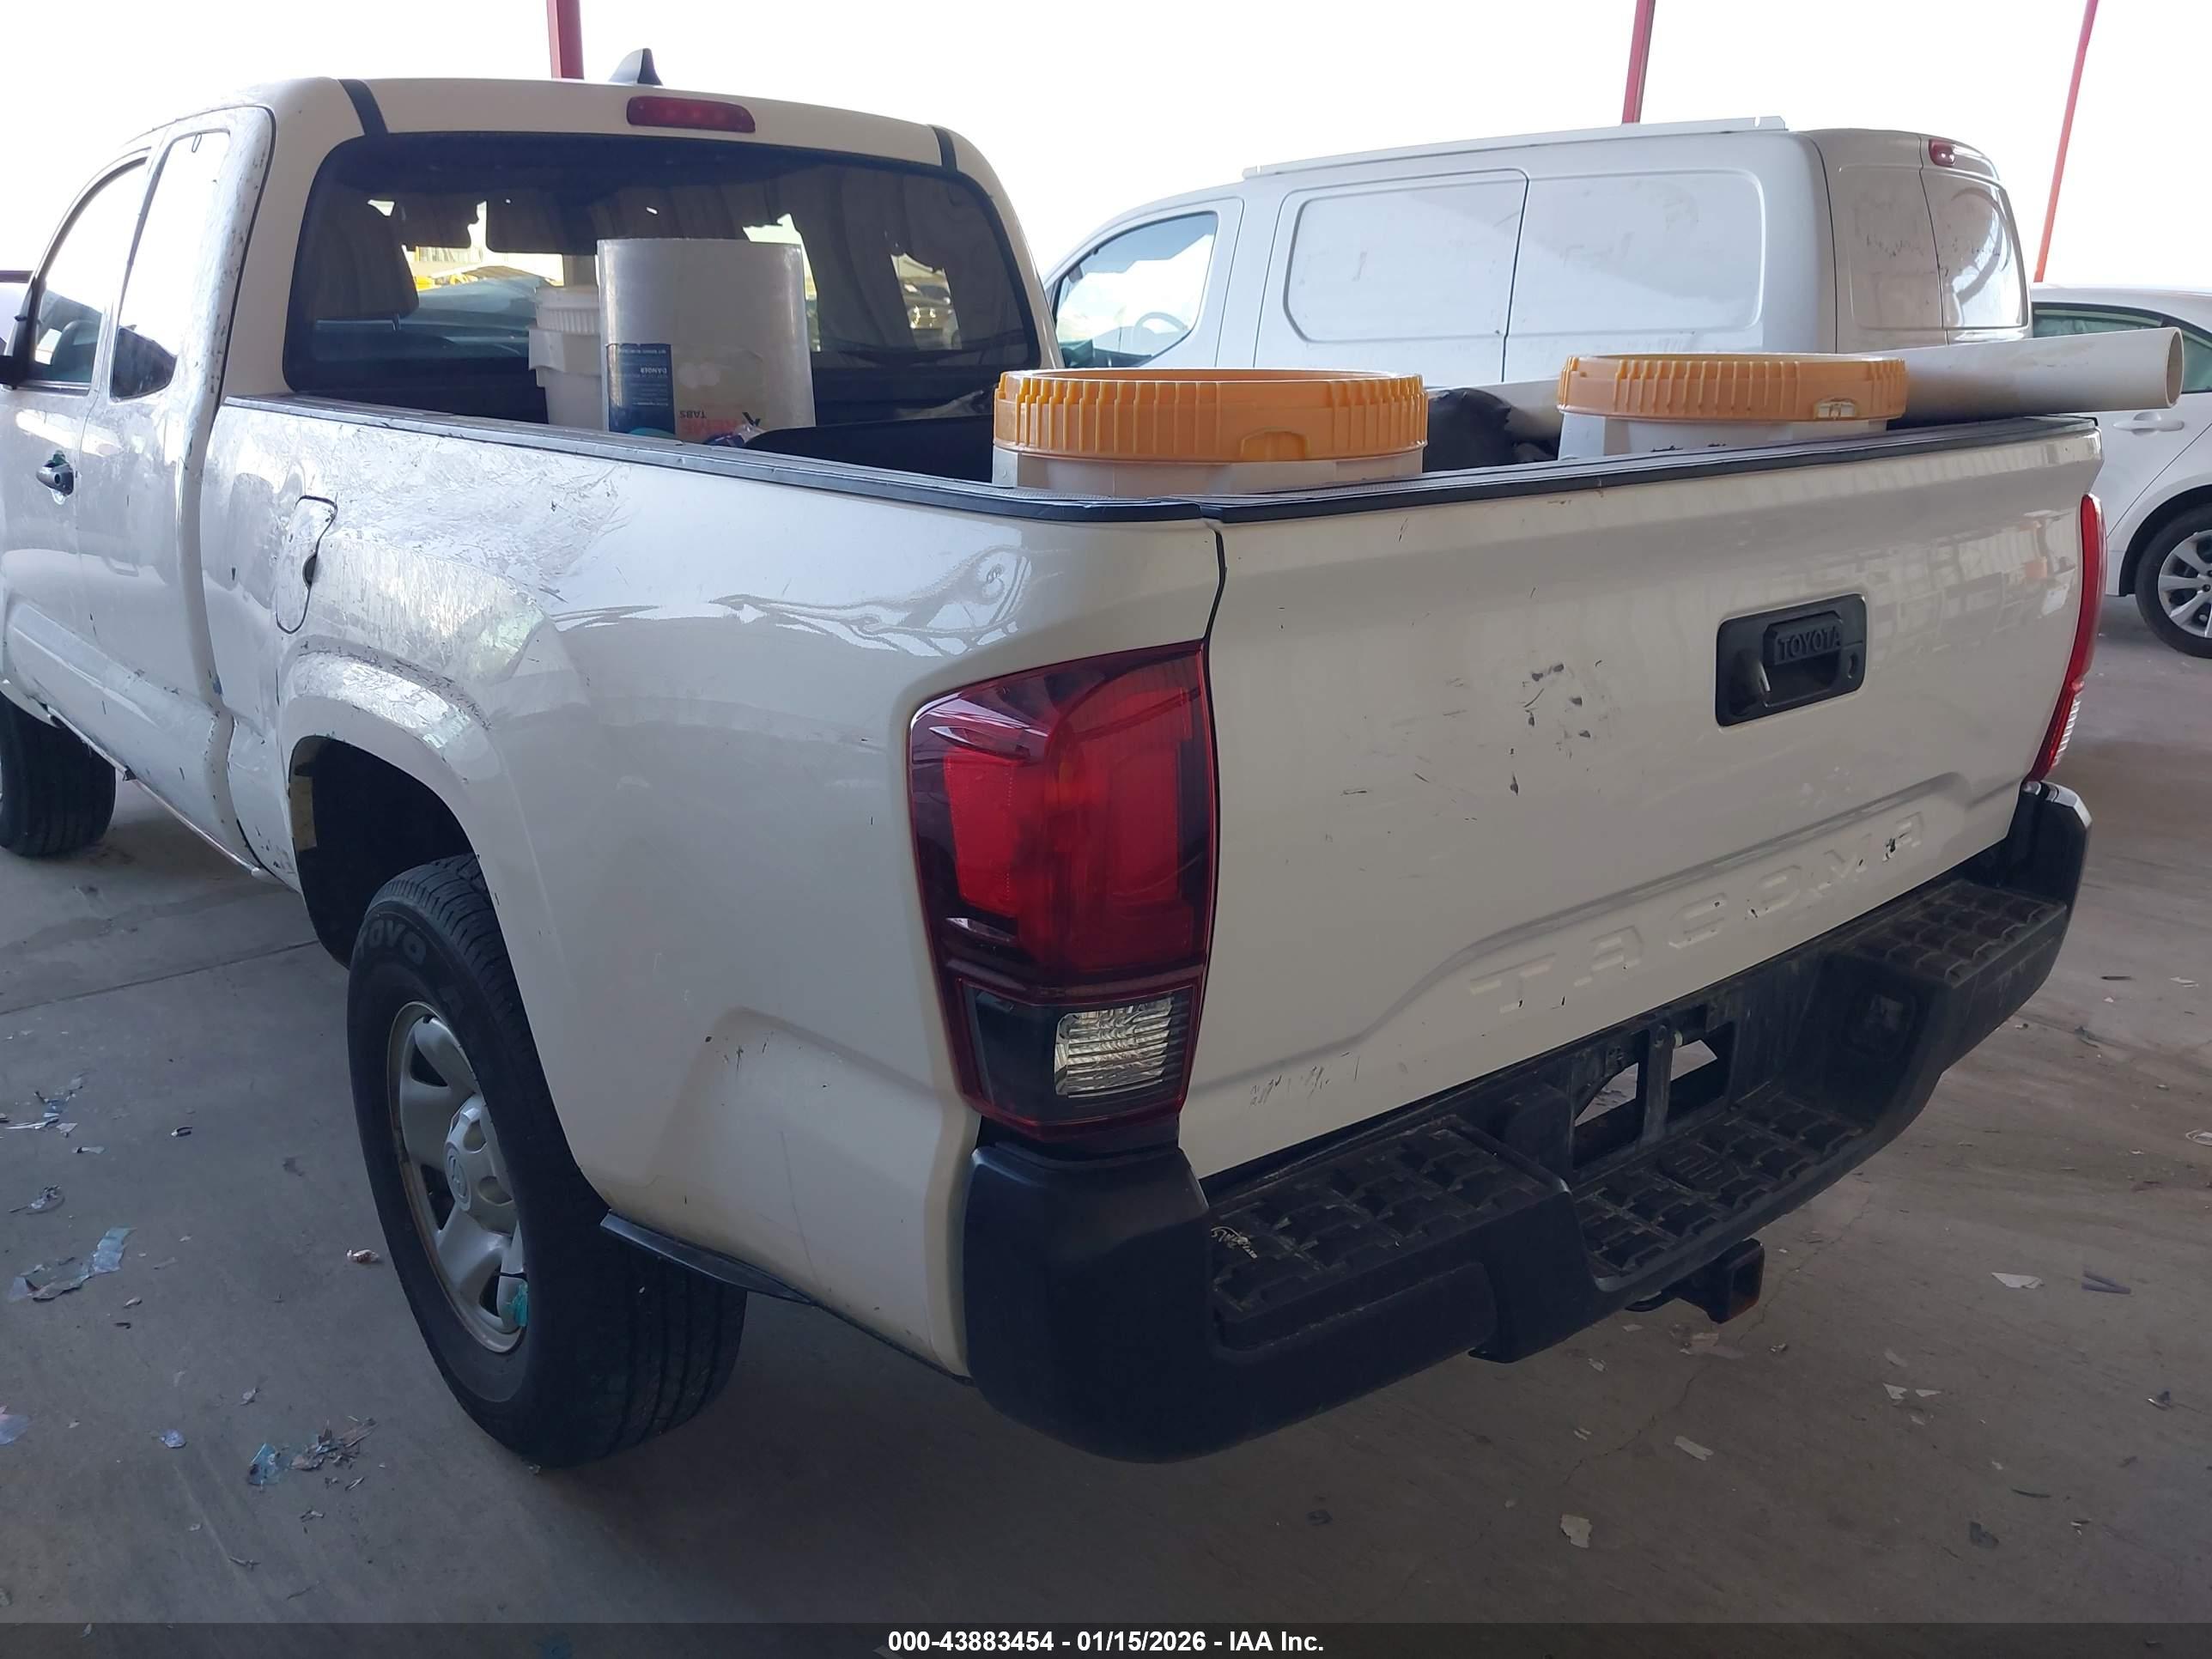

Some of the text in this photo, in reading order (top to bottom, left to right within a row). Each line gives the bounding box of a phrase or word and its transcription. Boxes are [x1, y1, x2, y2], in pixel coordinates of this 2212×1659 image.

[679, 410, 707, 419] TABS
[1777, 626, 1840, 660] TOYOTA
[1469, 811, 1924, 1014] TACOMA
